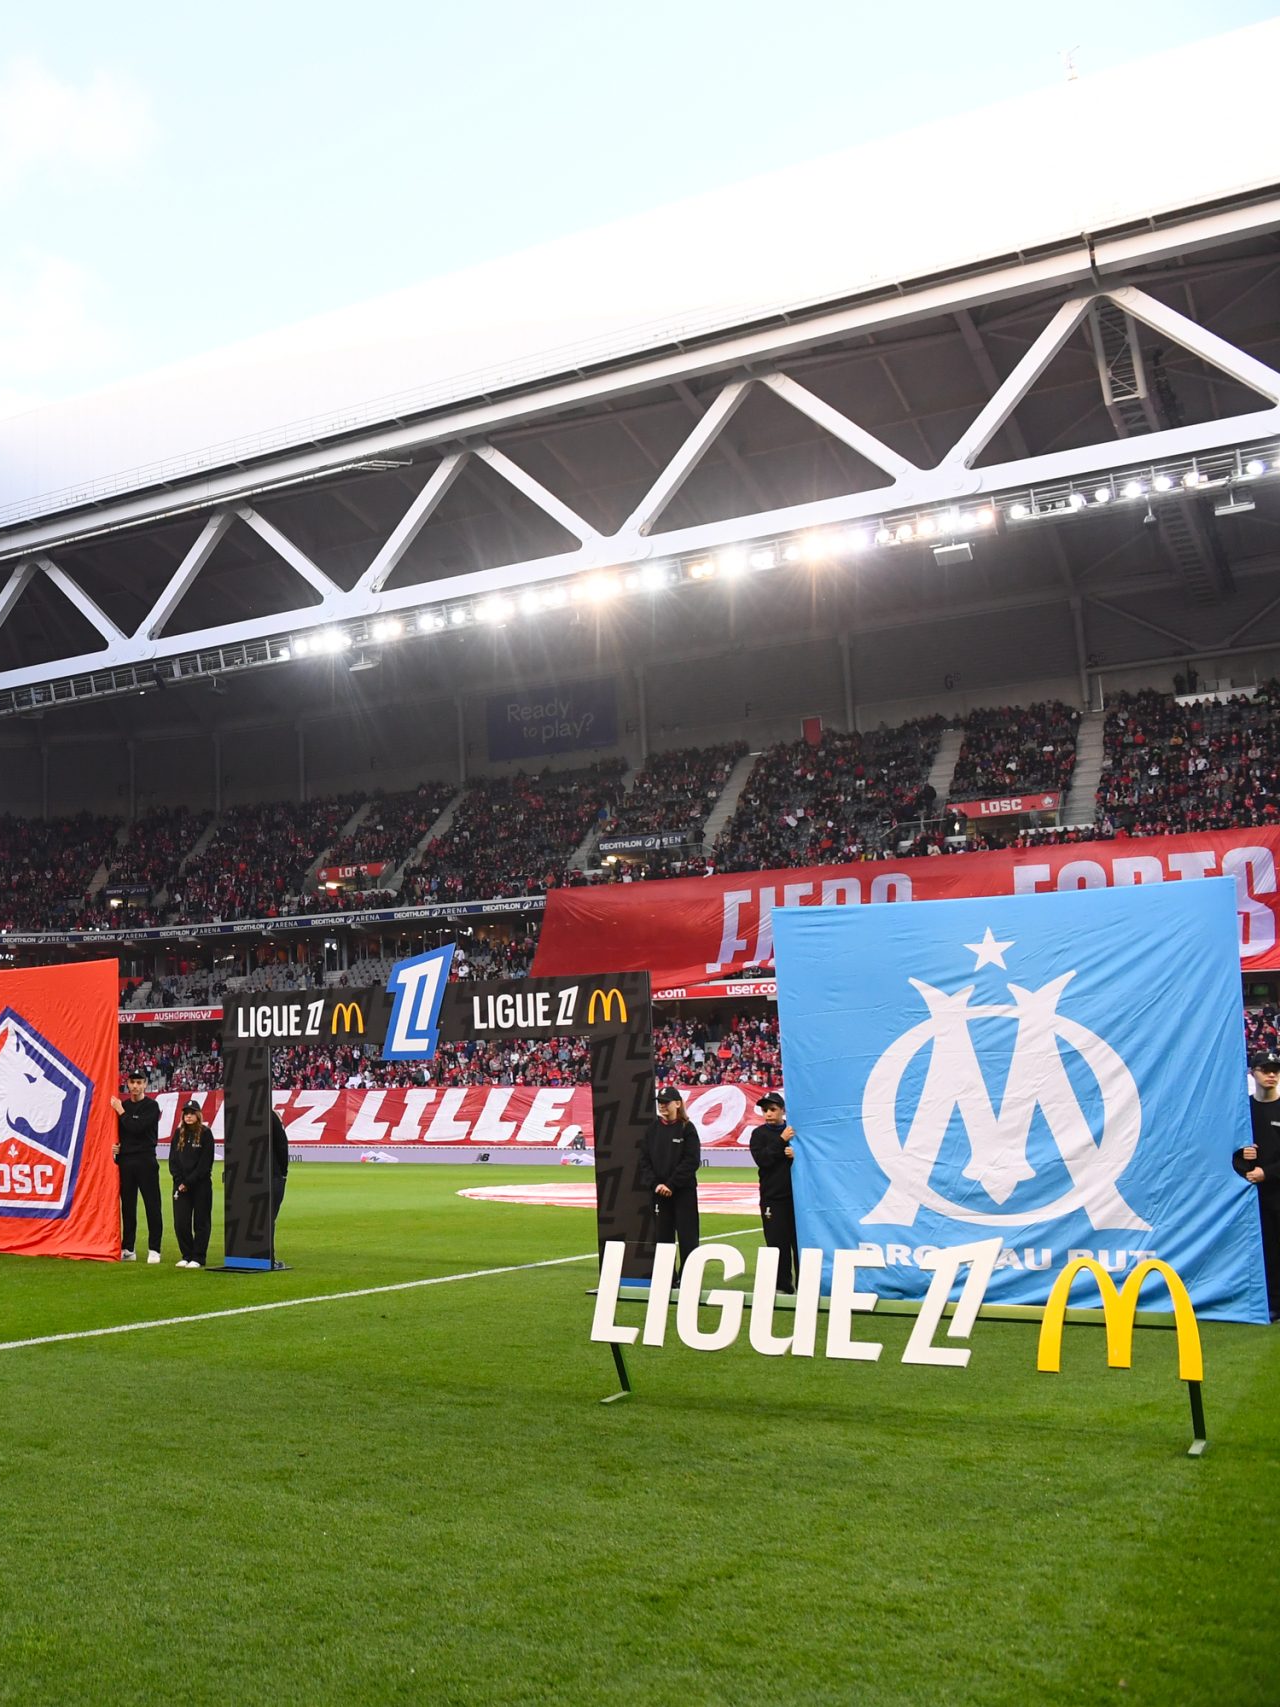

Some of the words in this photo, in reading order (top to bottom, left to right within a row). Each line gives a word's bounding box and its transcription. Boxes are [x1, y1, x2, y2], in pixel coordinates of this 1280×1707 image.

[507, 697, 570, 722] Ready
[523, 727, 538, 738] to
[542, 712, 594, 744] play?
[980, 799, 1022, 814] LOSC
[600, 840, 642, 850] DECATHLON
[394, 909, 430, 919] DECATHLON
[441, 906, 467, 915] ARENA
[482, 902, 520, 912] DECATHLON
[233, 923, 265, 932] DECATHLON
[275, 920, 298, 928] ARENA
[311, 916, 345, 925] DECATHLON
[355, 913, 380, 922] ARENA
[83, 934, 115, 942] DECATHLON
[160, 929, 190, 937] DECATHLON
[473, 992, 552, 1030] LIGUE
[237, 1005, 301, 1038] LIGUE
[345, 1088, 582, 1148] LILLE,
[287, 1153, 303, 1162] ron
[1003, 1247, 1052, 1270] AU
[590, 1240, 886, 1362] LIGUE
